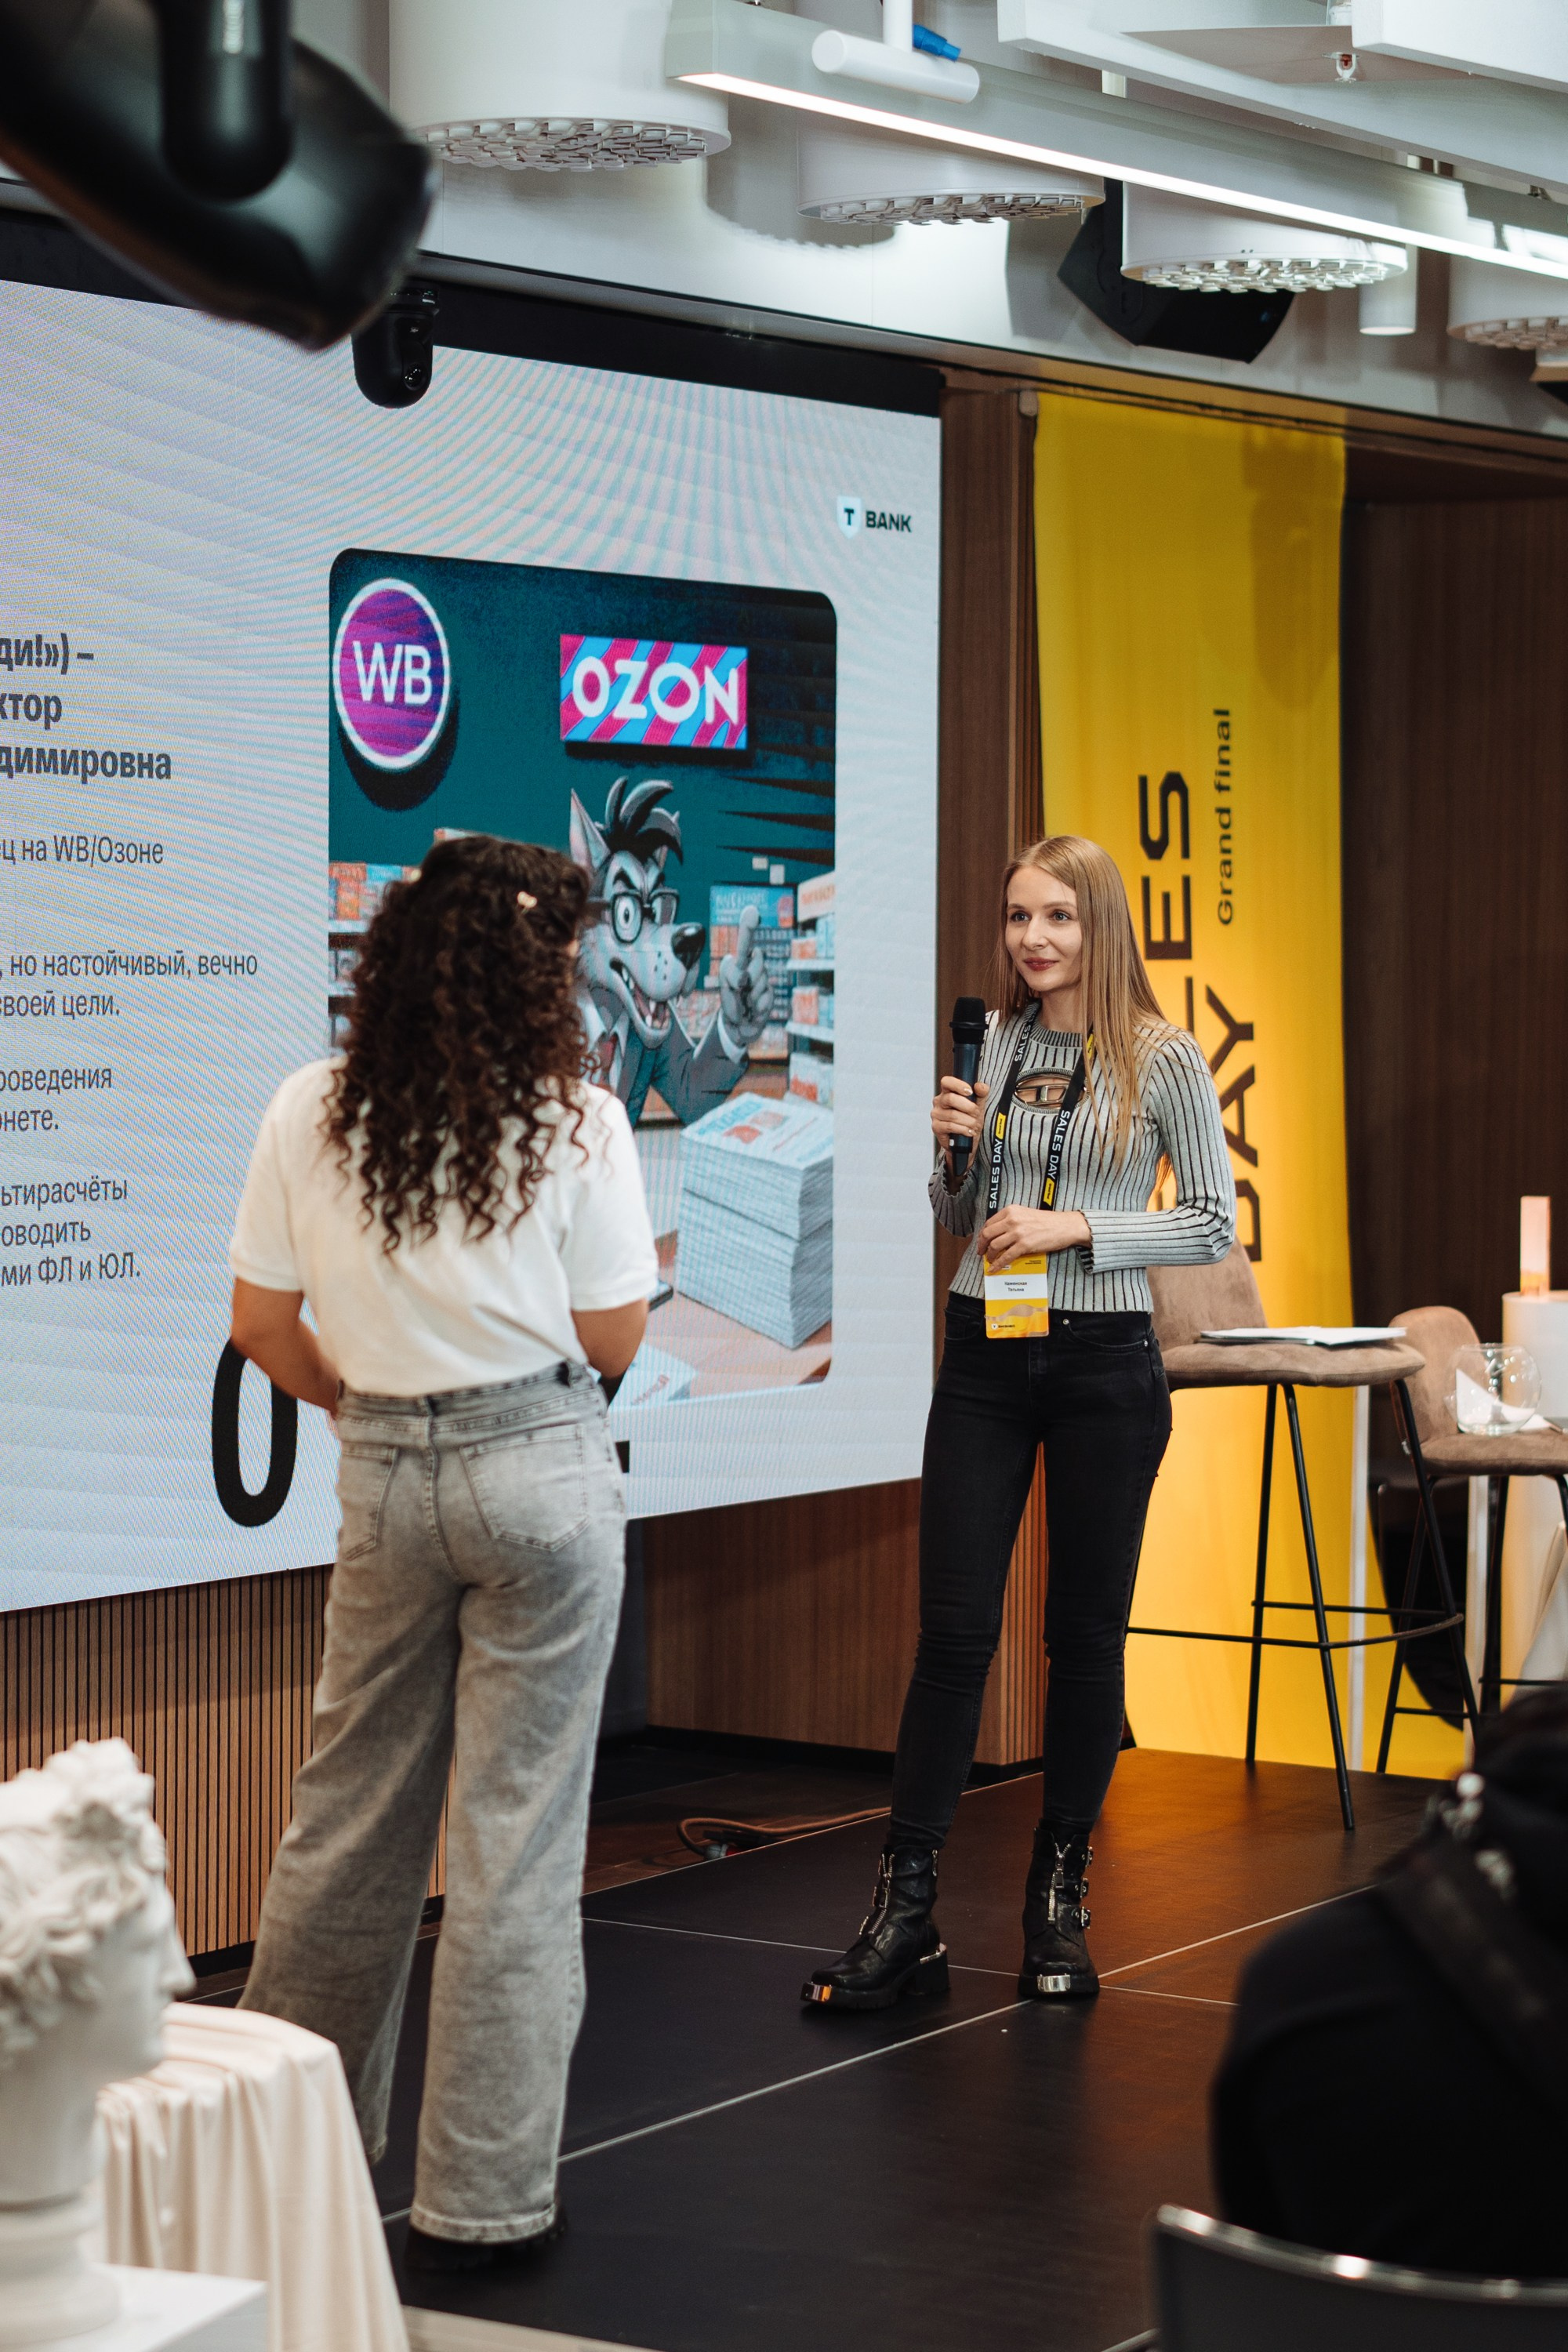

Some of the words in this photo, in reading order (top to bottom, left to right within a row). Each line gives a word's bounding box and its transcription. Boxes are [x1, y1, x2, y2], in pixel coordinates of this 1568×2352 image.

[866, 510, 911, 532] BANK
[352, 640, 433, 705] WB
[573, 656, 739, 726] OZON
[1214, 709, 1230, 793] final
[0, 840, 16, 865] ц
[23, 840, 47, 862] на
[54, 835, 163, 867] WB/Озоне
[1217, 807, 1233, 926] Grand
[11, 954, 37, 977] но
[43, 949, 191, 979] настойчивый,
[198, 953, 258, 976] вечно
[0, 990, 55, 1017] воей
[63, 992, 120, 1019] цели.
[0, 1109, 59, 1133] нете.
[1051, 1110, 1071, 1152] SALES
[993, 1138, 1003, 1163] DAY
[1047, 1154, 1059, 1180] DAY
[1, 1176, 128, 1210] ьтирасчёты
[989, 1166, 1000, 1209] SALES
[1, 1221, 91, 1249] оводить
[1, 1263, 31, 1287] ми
[38, 1255, 72, 1283] ФЛ
[80, 1261, 92, 1280] и
[99, 1252, 140, 1279] ЮЛ.
